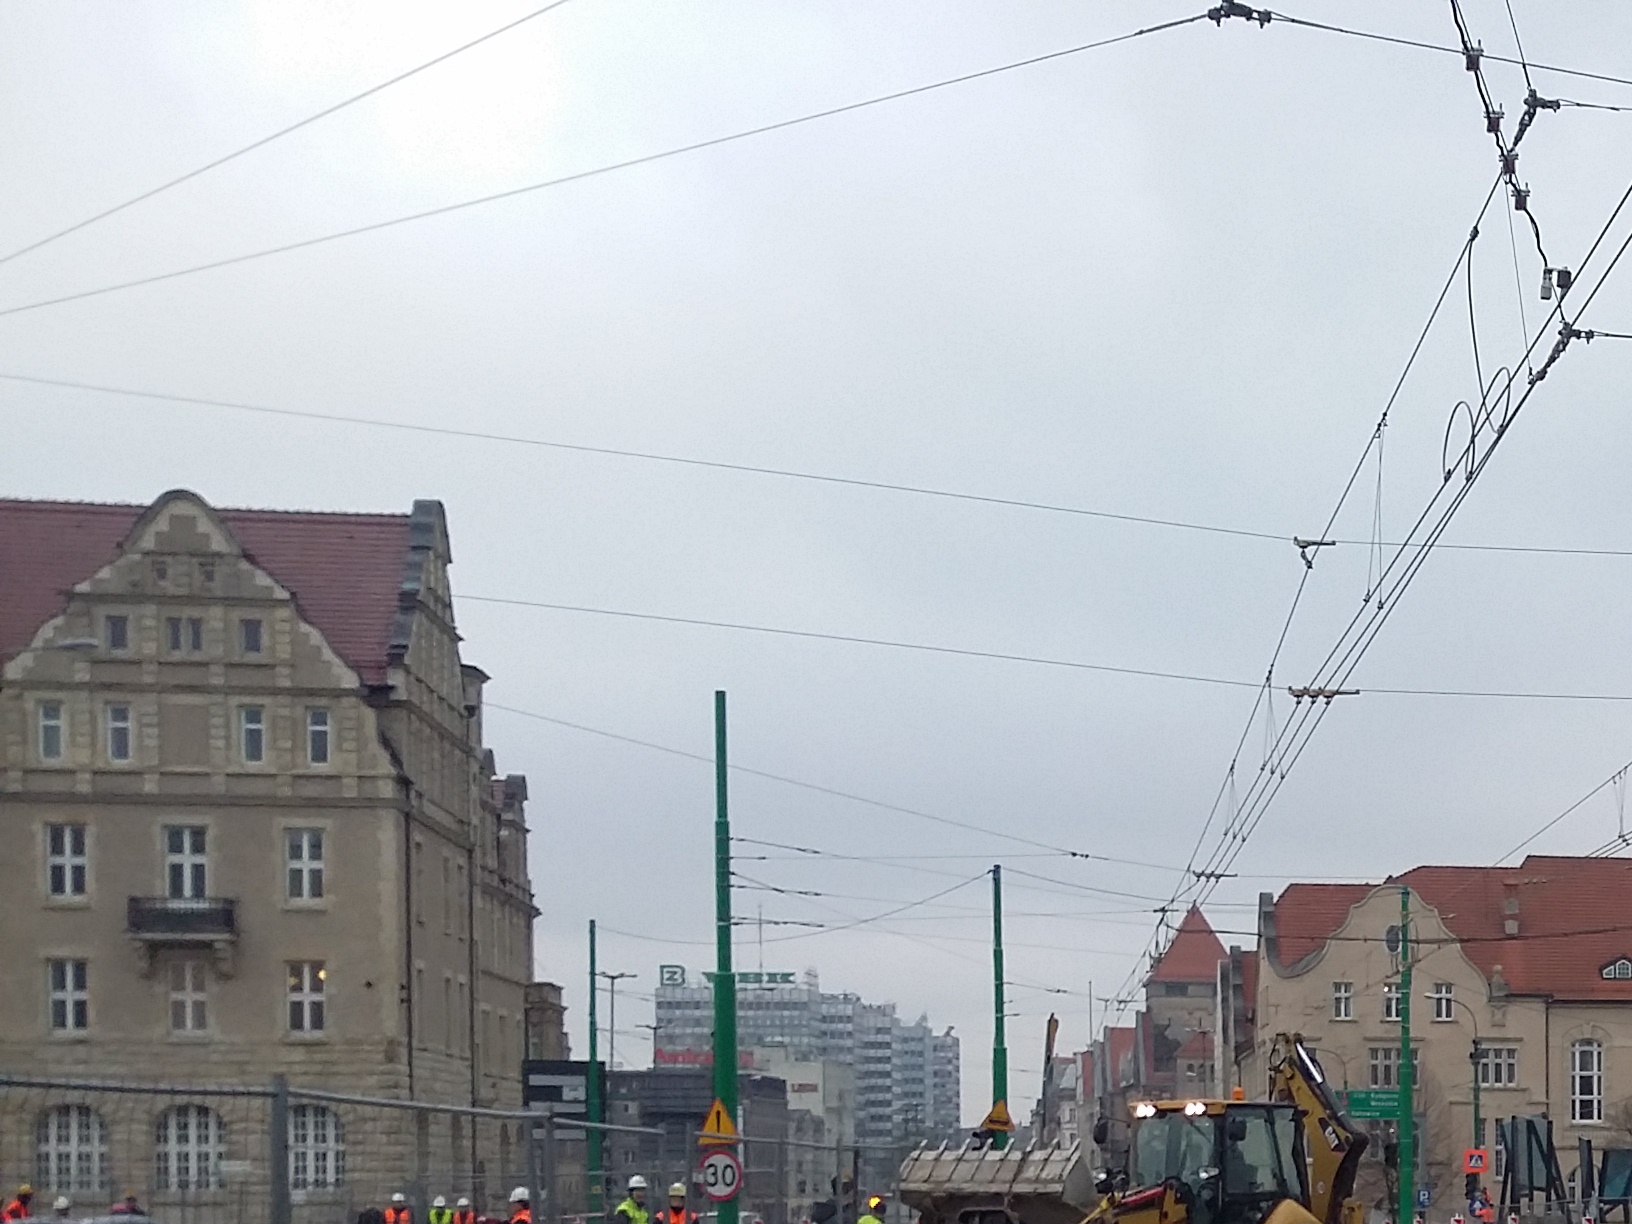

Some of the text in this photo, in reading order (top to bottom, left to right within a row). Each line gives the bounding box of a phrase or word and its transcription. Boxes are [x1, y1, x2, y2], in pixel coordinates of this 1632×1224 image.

[1325, 1125, 1340, 1149] CAT
[706, 1163, 735, 1187] 30
[1419, 1190, 1429, 1201] P
